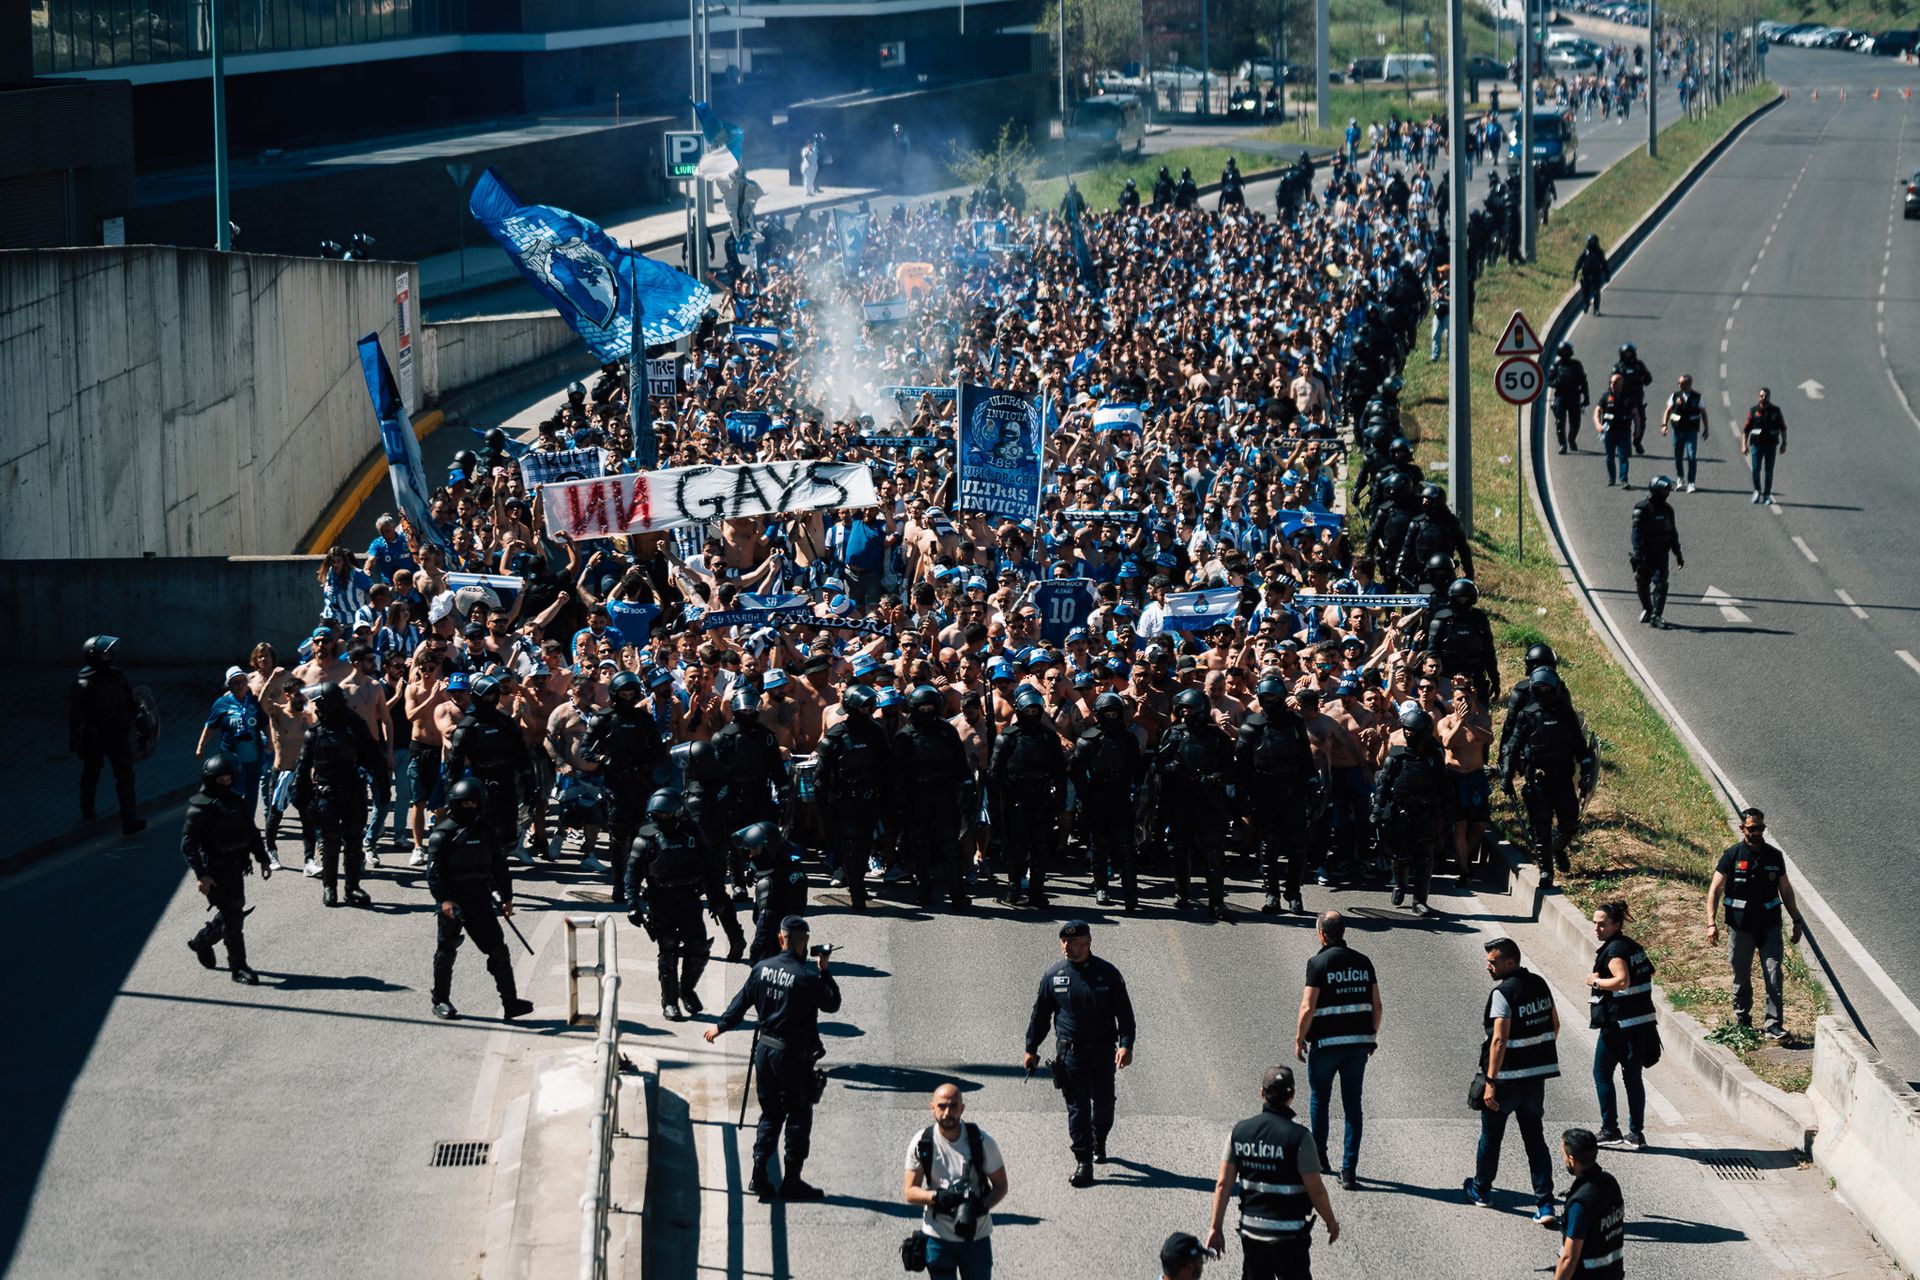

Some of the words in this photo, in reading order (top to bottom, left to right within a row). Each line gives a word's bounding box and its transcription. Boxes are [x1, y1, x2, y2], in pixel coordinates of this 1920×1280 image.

[672, 136, 698, 163] P
[1505, 371, 1535, 390] 50
[988, 394, 1028, 410] ULTRAS
[986, 408, 1029, 422] INVICTA
[866, 438, 904, 447] FUCK
[910, 438, 938, 448] SLB
[986, 456, 1018, 469] 1893
[676, 460, 849, 525] GAYS
[961, 479, 1029, 502] ULTRAS
[962, 495, 1037, 518] INVICTA
[1049, 597, 1076, 624] 10
[782, 613, 893, 637] AMADORA
[761, 966, 796, 987] POLÍCIA
[1327, 967, 1369, 984] POLÍCIA
[1336, 986, 1367, 994] SPOTTERS
[1234, 1140, 1284, 1159] POLÍCIA
